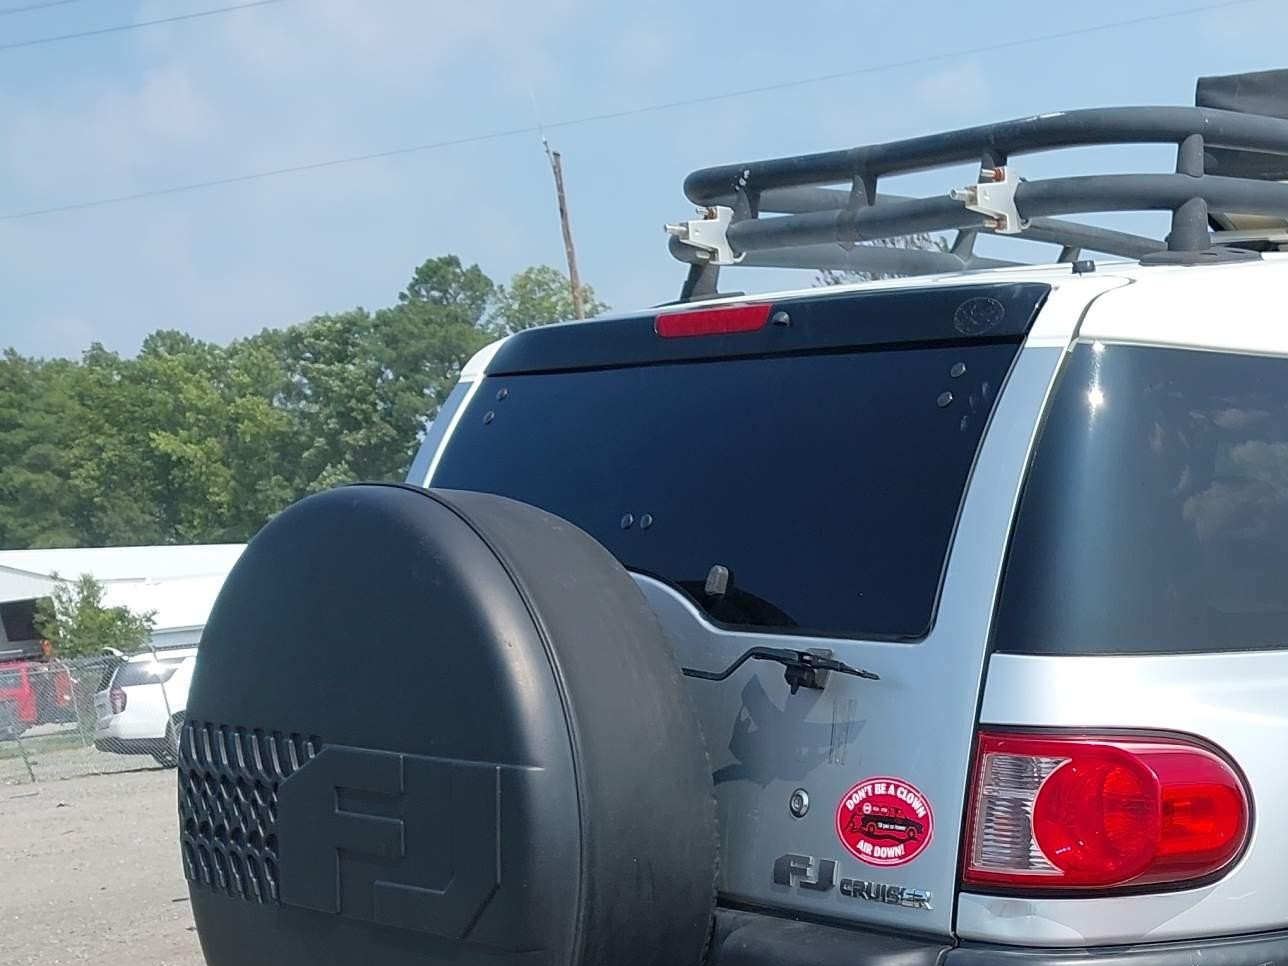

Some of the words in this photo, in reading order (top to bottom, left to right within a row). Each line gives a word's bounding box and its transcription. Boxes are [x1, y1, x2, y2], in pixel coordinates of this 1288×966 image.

[846, 784, 873, 811] DON'T
[874, 783, 888, 795] BE
[888, 784, 895, 795] A
[896, 786, 927, 818] CLOWN
[856, 840, 873, 855] AIR
[873, 843, 905, 858] DOWN!
[773, 853, 838, 892] FJ
[839, 878, 934, 910] CRUISER
